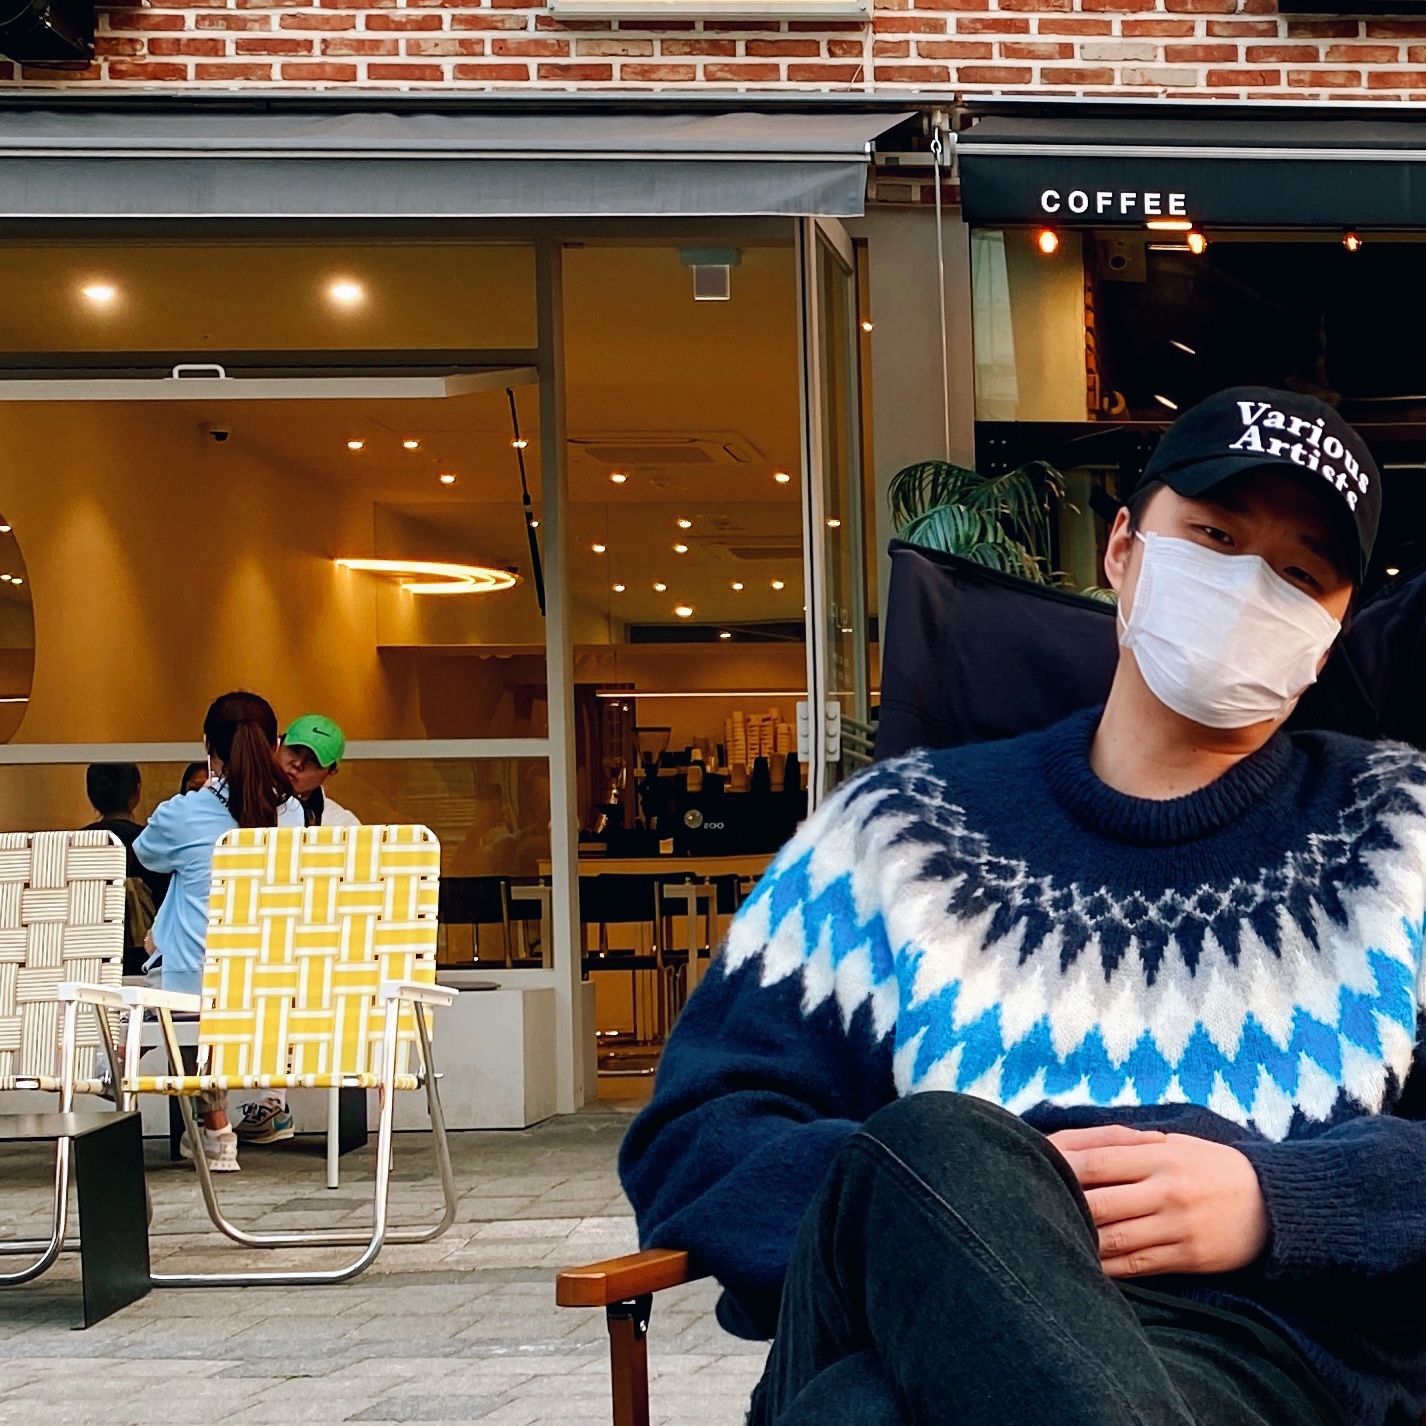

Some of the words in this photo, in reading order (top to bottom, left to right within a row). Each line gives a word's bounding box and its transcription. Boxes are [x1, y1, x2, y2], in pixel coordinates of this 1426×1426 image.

[1041, 189, 1187, 215] COFFEE
[1228, 425, 1358, 512] Artists
[1236, 401, 1369, 494] Various
